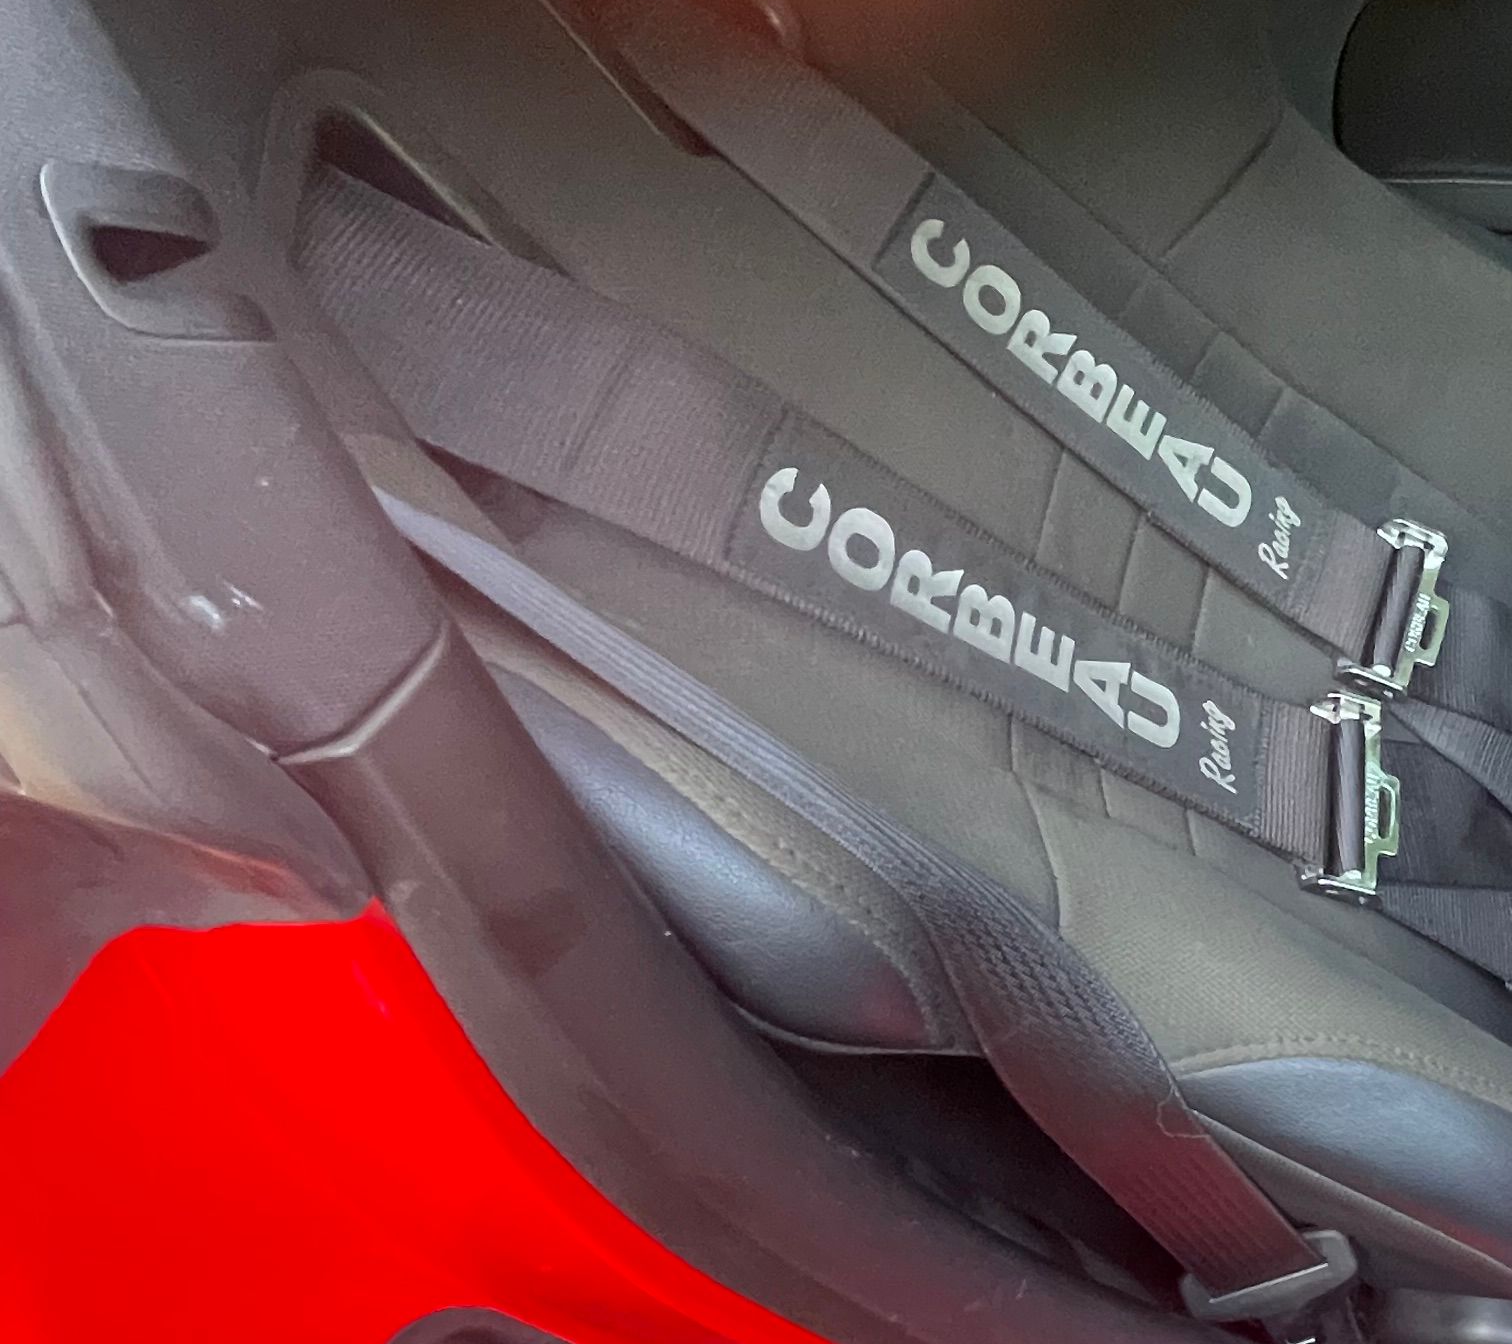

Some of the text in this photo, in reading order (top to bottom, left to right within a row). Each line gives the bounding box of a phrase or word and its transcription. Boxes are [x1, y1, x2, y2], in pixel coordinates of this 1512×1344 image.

[910, 219, 1301, 580] CORBEAU Racing
[759, 467, 1238, 794] CORBEAU Racing
